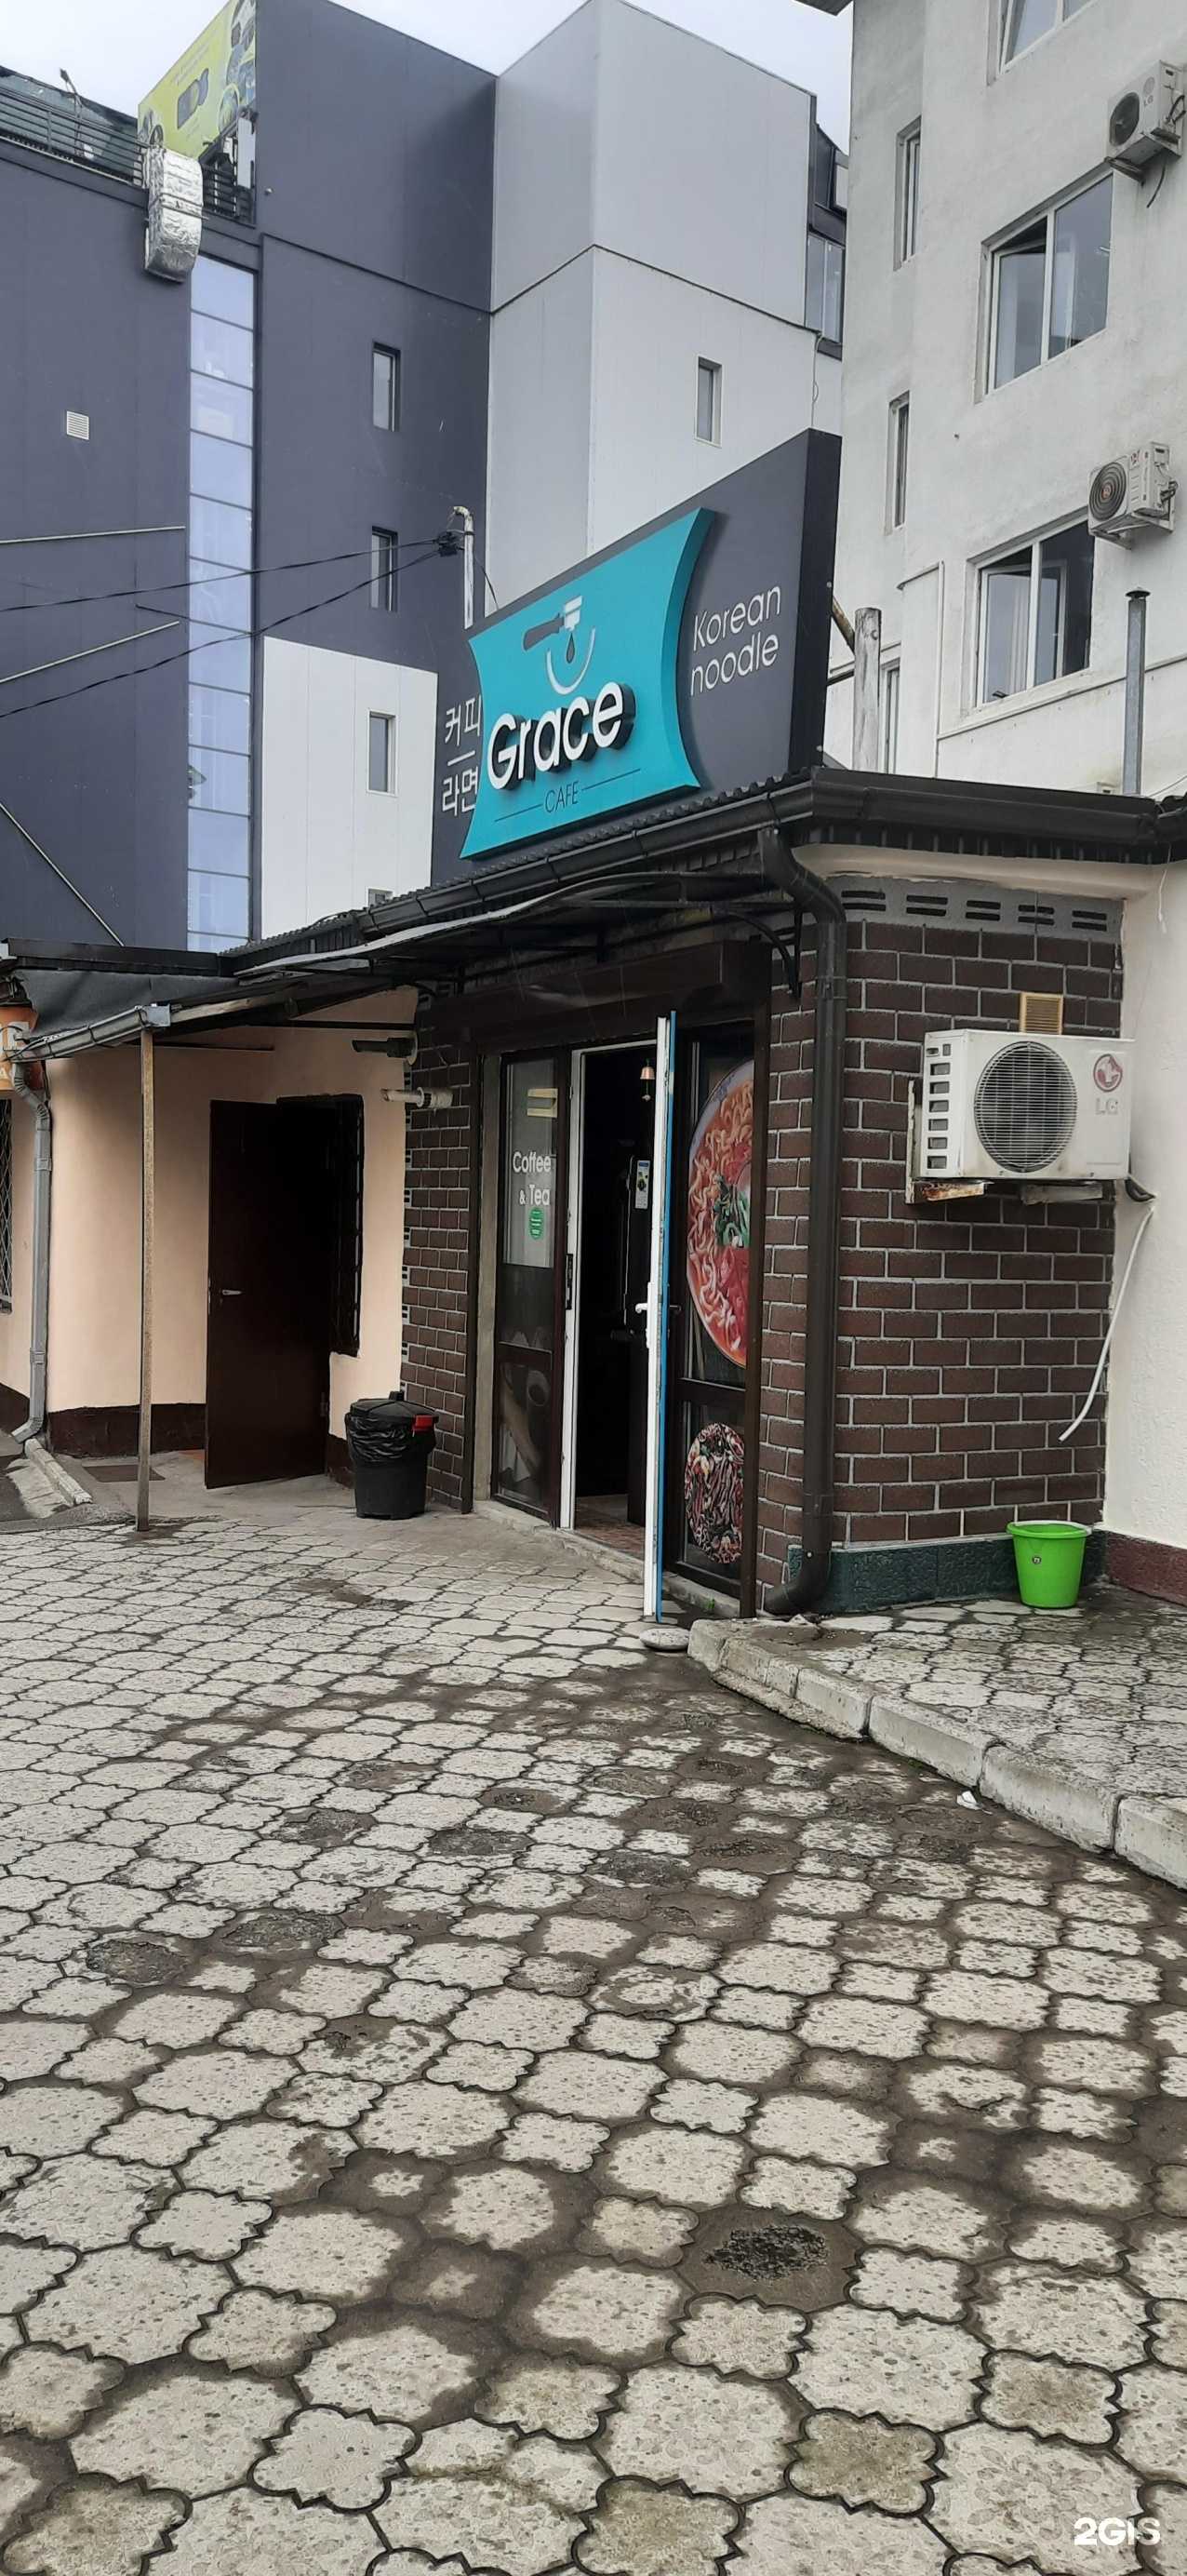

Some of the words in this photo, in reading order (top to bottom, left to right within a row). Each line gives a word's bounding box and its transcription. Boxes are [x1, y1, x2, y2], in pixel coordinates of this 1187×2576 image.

[693, 585, 780, 651] Korean
[690, 631, 779, 696] noodle
[445, 694, 482, 746] 커피
[487, 681, 624, 790] Grace
[442, 766, 479, 816] 라면
[544, 780, 580, 813] CAFE
[1096, 1097, 1119, 1116] LG
[513, 1151, 552, 1173] Coffee
[519, 1189, 526, 1205] &
[528, 1184, 551, 1206] Tea
